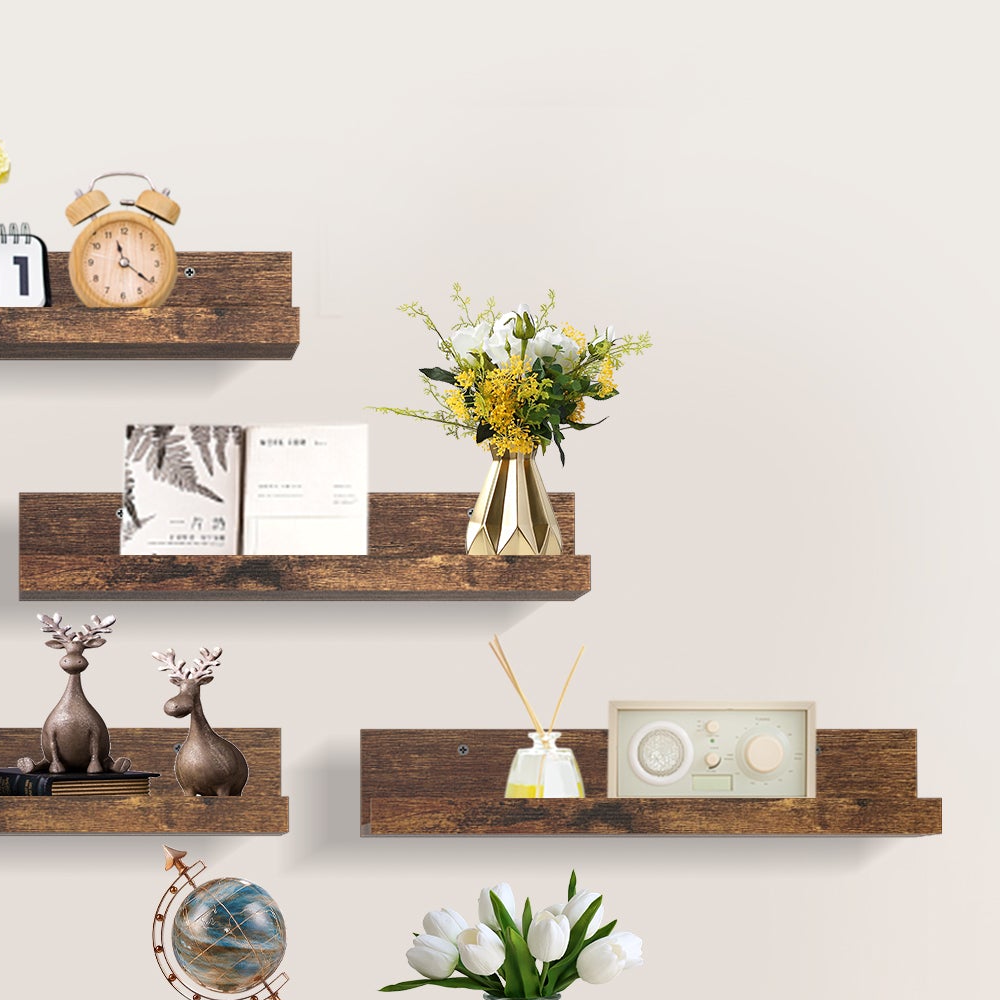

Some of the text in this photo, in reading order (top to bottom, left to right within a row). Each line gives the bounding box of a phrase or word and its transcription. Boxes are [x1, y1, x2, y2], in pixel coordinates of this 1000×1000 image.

[104, 231, 113, 240] 11
[120, 227, 129, 236] 12
[92, 242, 101, 251] 10
[150, 243, 156, 251] 2
[87, 258, 94, 267] 9
[154, 259, 160, 268] 3
[93, 274, 99, 283] 8
[104, 286, 110, 295] 7
[137, 286, 143, 295] 5
[120, 291, 126, 300] 6
